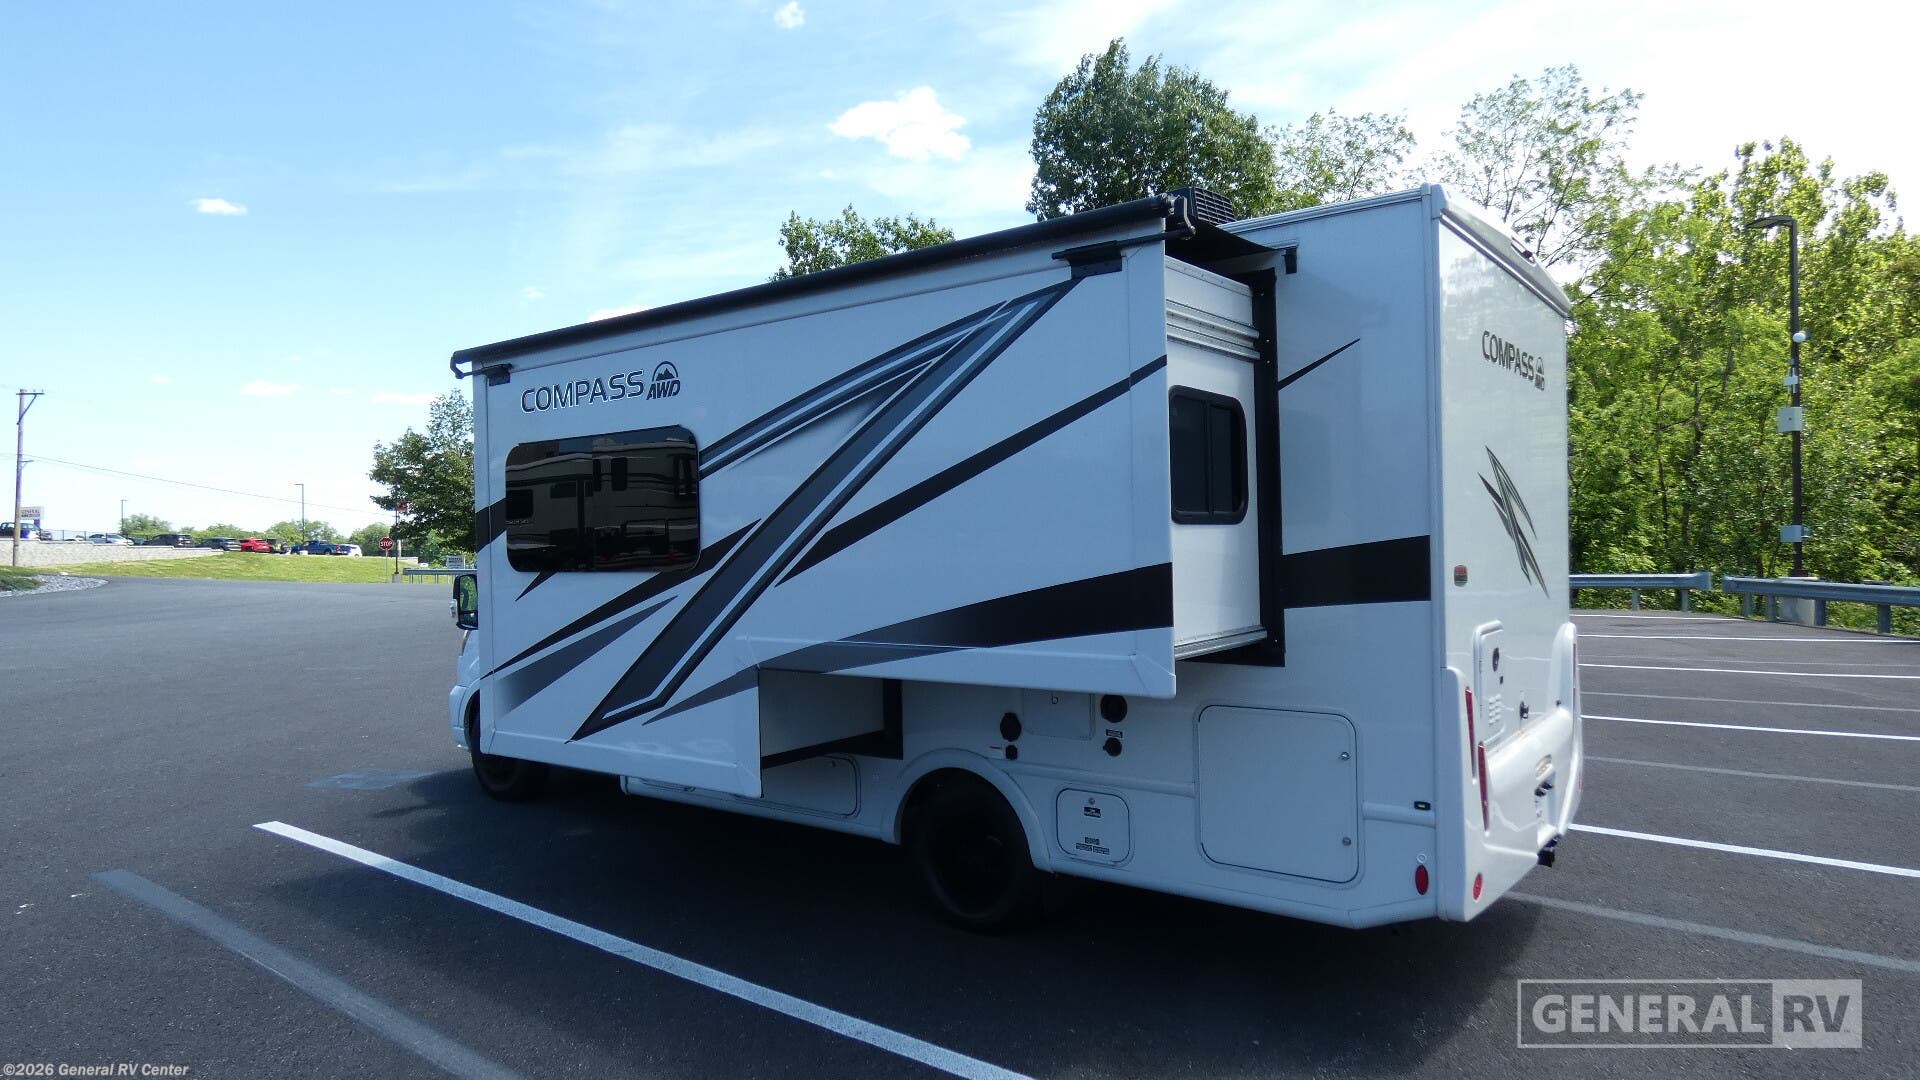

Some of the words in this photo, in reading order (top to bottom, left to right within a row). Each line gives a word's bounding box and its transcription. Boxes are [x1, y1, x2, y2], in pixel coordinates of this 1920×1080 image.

[1482, 330, 1534, 381] COMPASS
[521, 370, 644, 413] COMPASS
[646, 379, 681, 400] AWD
